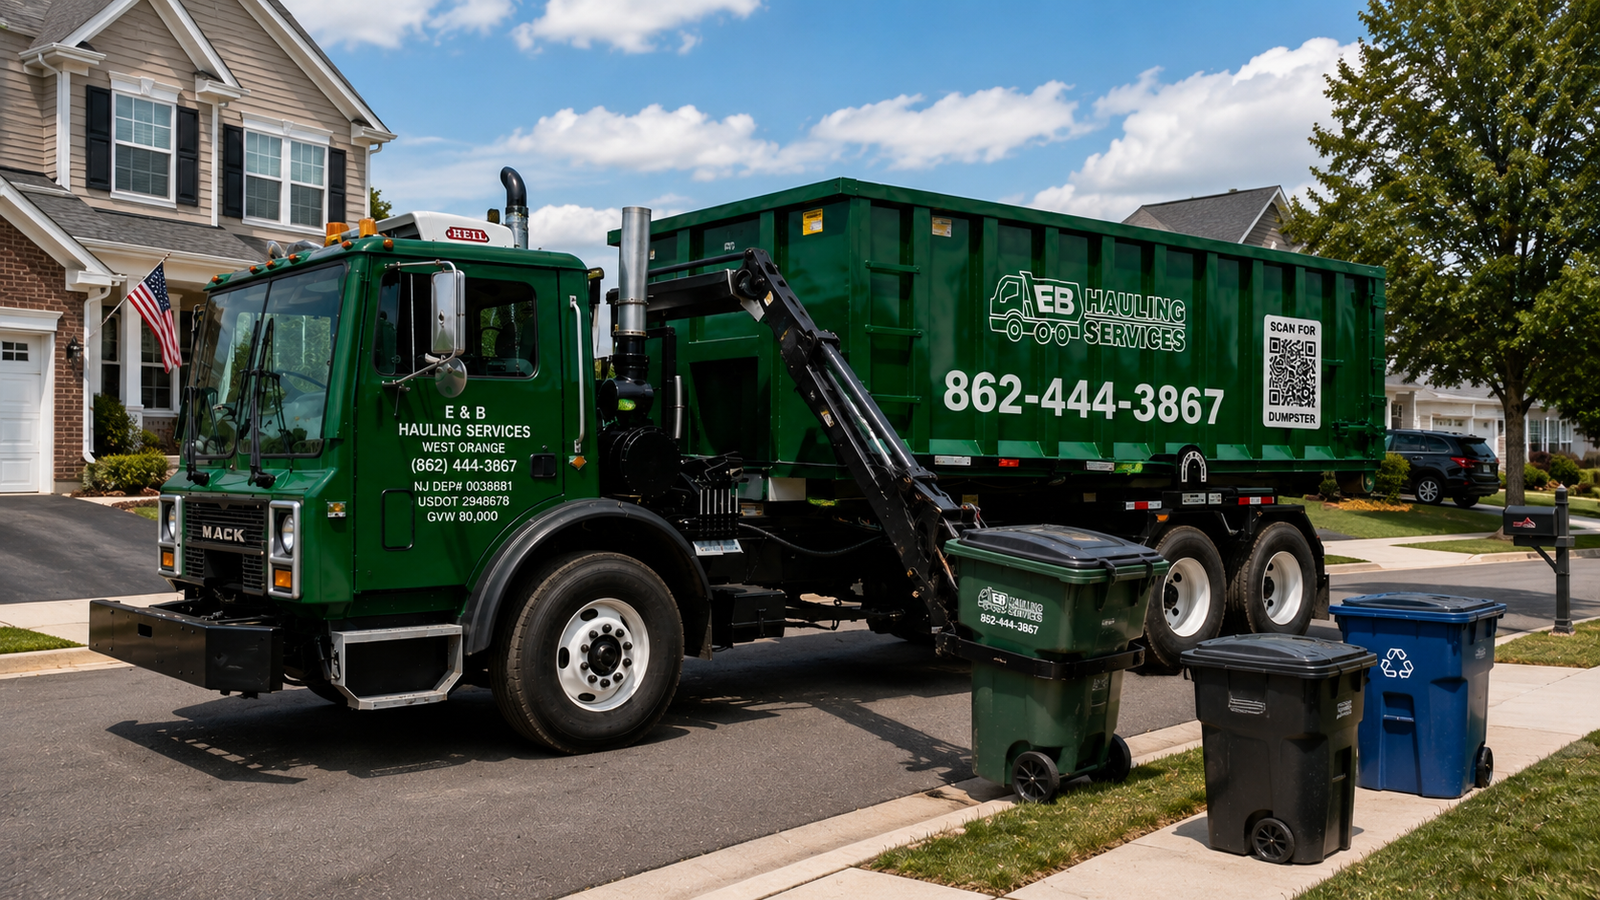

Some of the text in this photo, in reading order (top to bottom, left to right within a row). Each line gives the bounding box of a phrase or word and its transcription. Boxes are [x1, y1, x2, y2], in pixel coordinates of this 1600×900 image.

[452, 228, 488, 240] HEIL
[1033, 284, 1075, 316] EB
[1084, 288, 1186, 323] HAULING
[1084, 320, 1186, 352] SERVICES
[1270, 321, 1316, 336] SCAN FOR
[943, 369, 1225, 425] 862-444-3867
[445, 405, 486, 420] E & B
[1268, 411, 1316, 424] DUMPSTER
[398, 423, 531, 438] HAULING SERVICES
[422, 441, 506, 453] WEST ORANGE
[411, 458, 518, 474] (862) 444-3867
[414, 481, 429, 492] NJ
[433, 481, 463, 492] DEP#
[418, 496, 510, 507] USDOT 2948678
[427, 510, 498, 524] GVW 80,000
[202, 525, 245, 543] MACK
